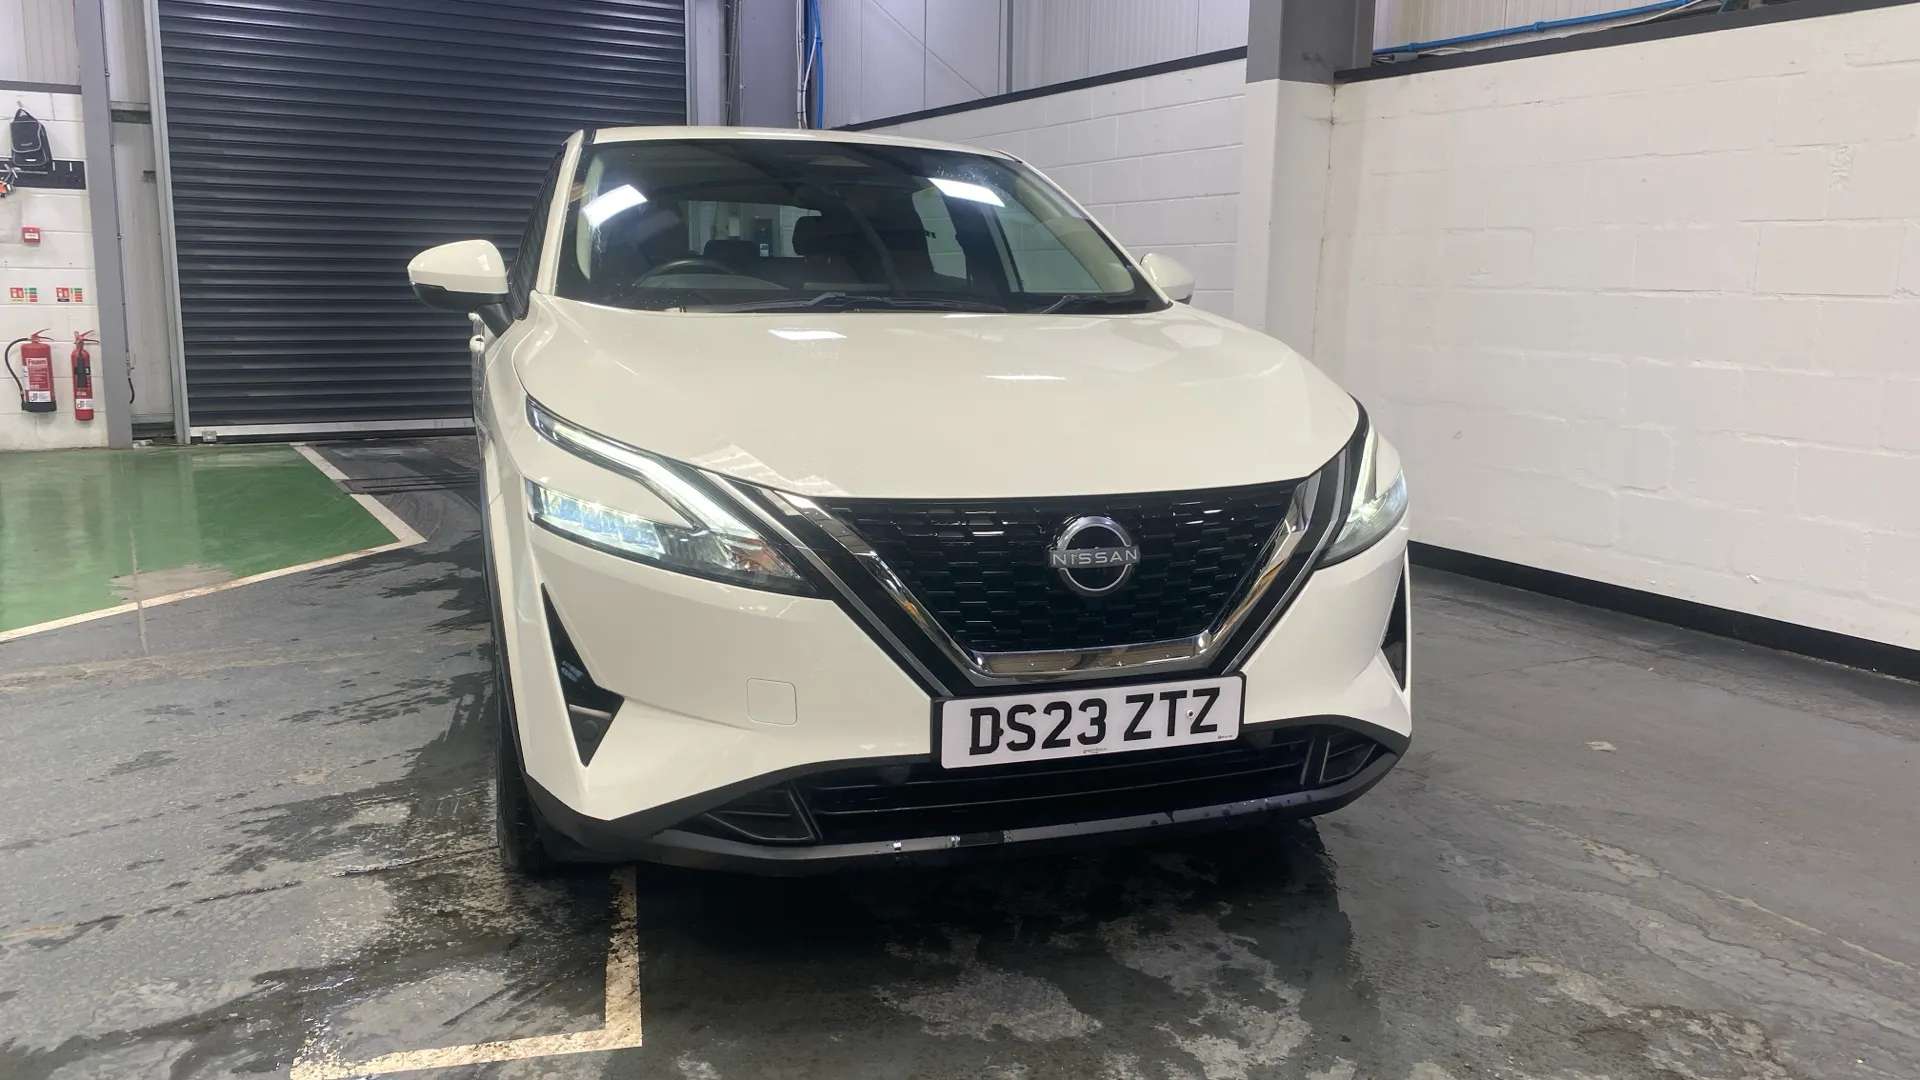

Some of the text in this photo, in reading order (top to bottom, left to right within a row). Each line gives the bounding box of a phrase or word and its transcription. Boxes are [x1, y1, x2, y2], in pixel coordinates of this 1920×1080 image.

[1052, 548, 1137, 565] NISSAN
[969, 687, 1220, 755] DS23 ZTZ
